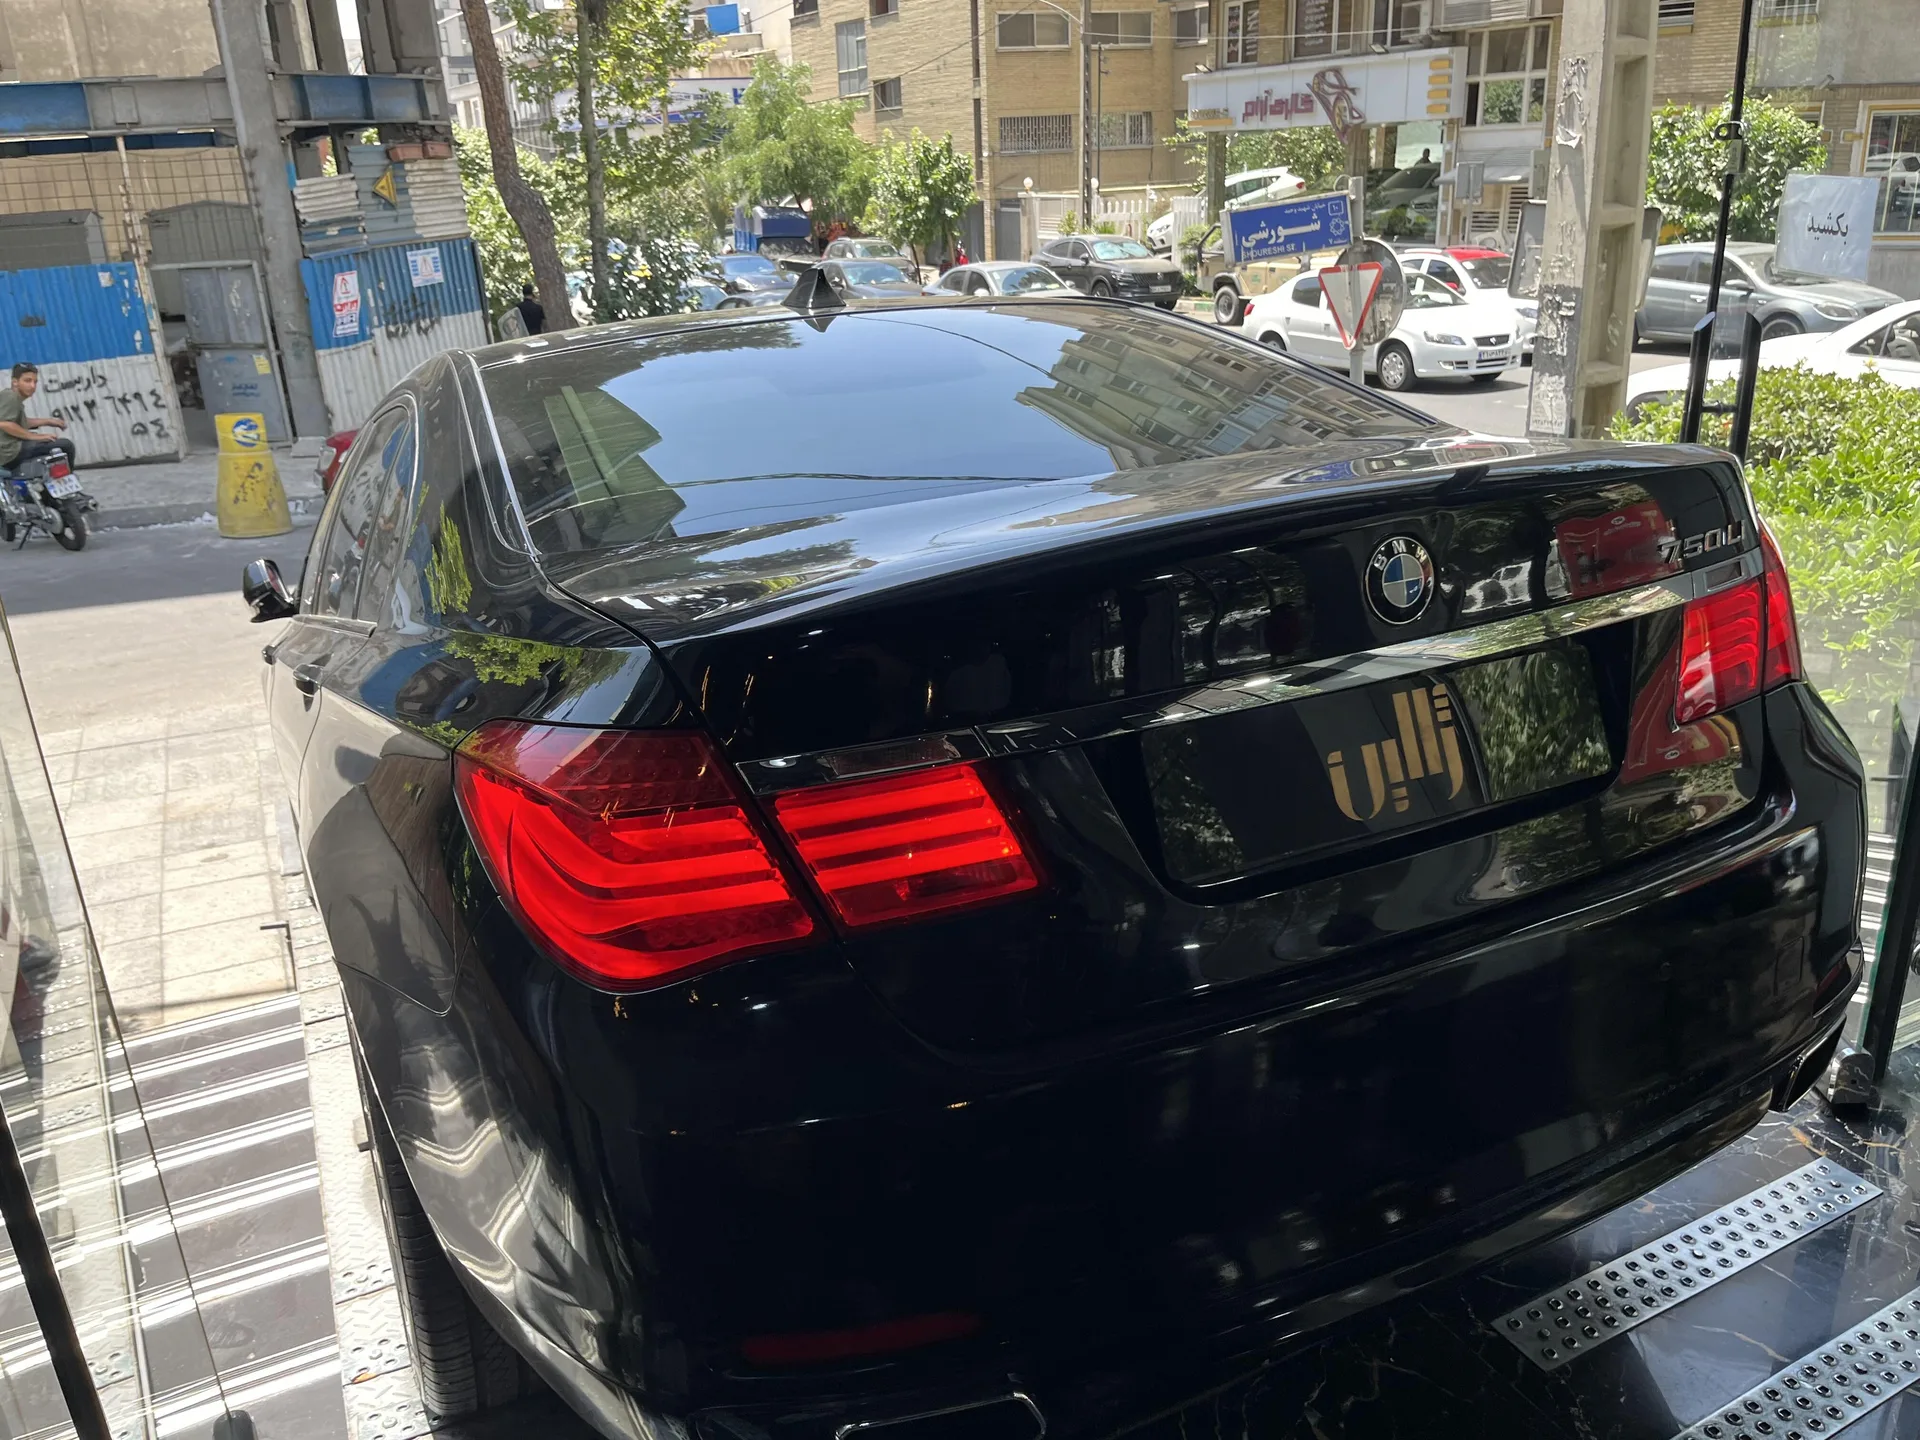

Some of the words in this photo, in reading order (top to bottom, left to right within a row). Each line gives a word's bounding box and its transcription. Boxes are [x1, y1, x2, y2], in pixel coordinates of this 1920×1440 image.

[1241, 212, 1321, 248] شورشی
[1807, 212, 1848, 245] بکشید
[44, 366, 107, 393] داربست
[1373, 540, 1428, 571] BMW
